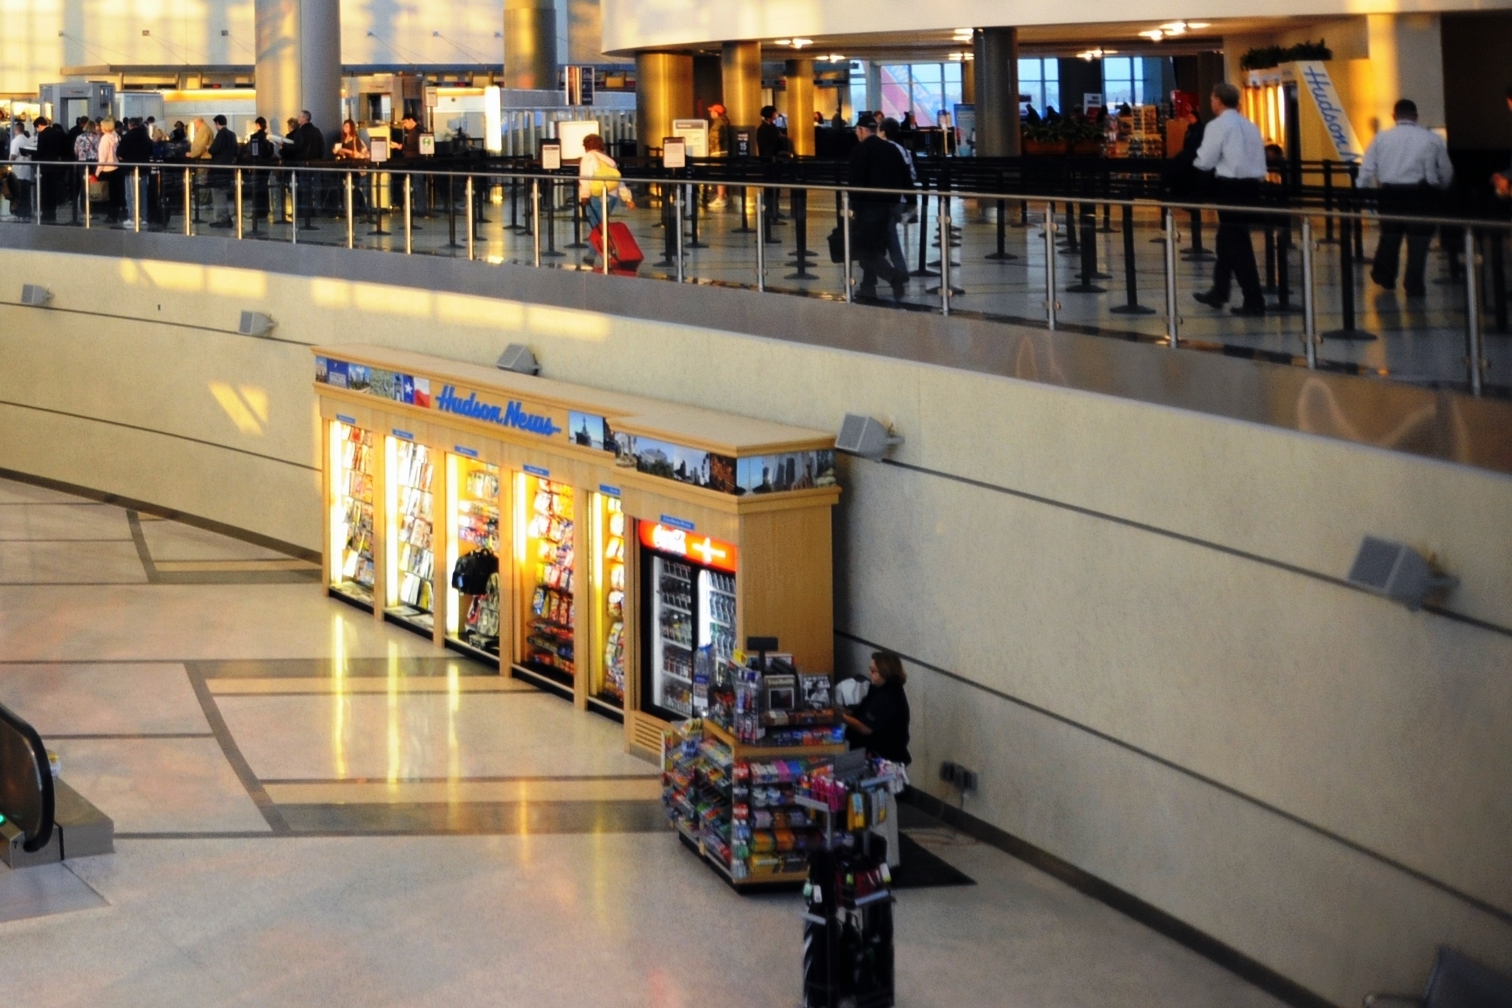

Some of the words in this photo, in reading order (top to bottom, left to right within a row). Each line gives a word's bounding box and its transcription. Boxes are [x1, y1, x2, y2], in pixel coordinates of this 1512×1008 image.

[1303, 65, 1349, 149] Hudson
[435, 384, 504, 424] Hudson
[503, 400, 562, 437] News
